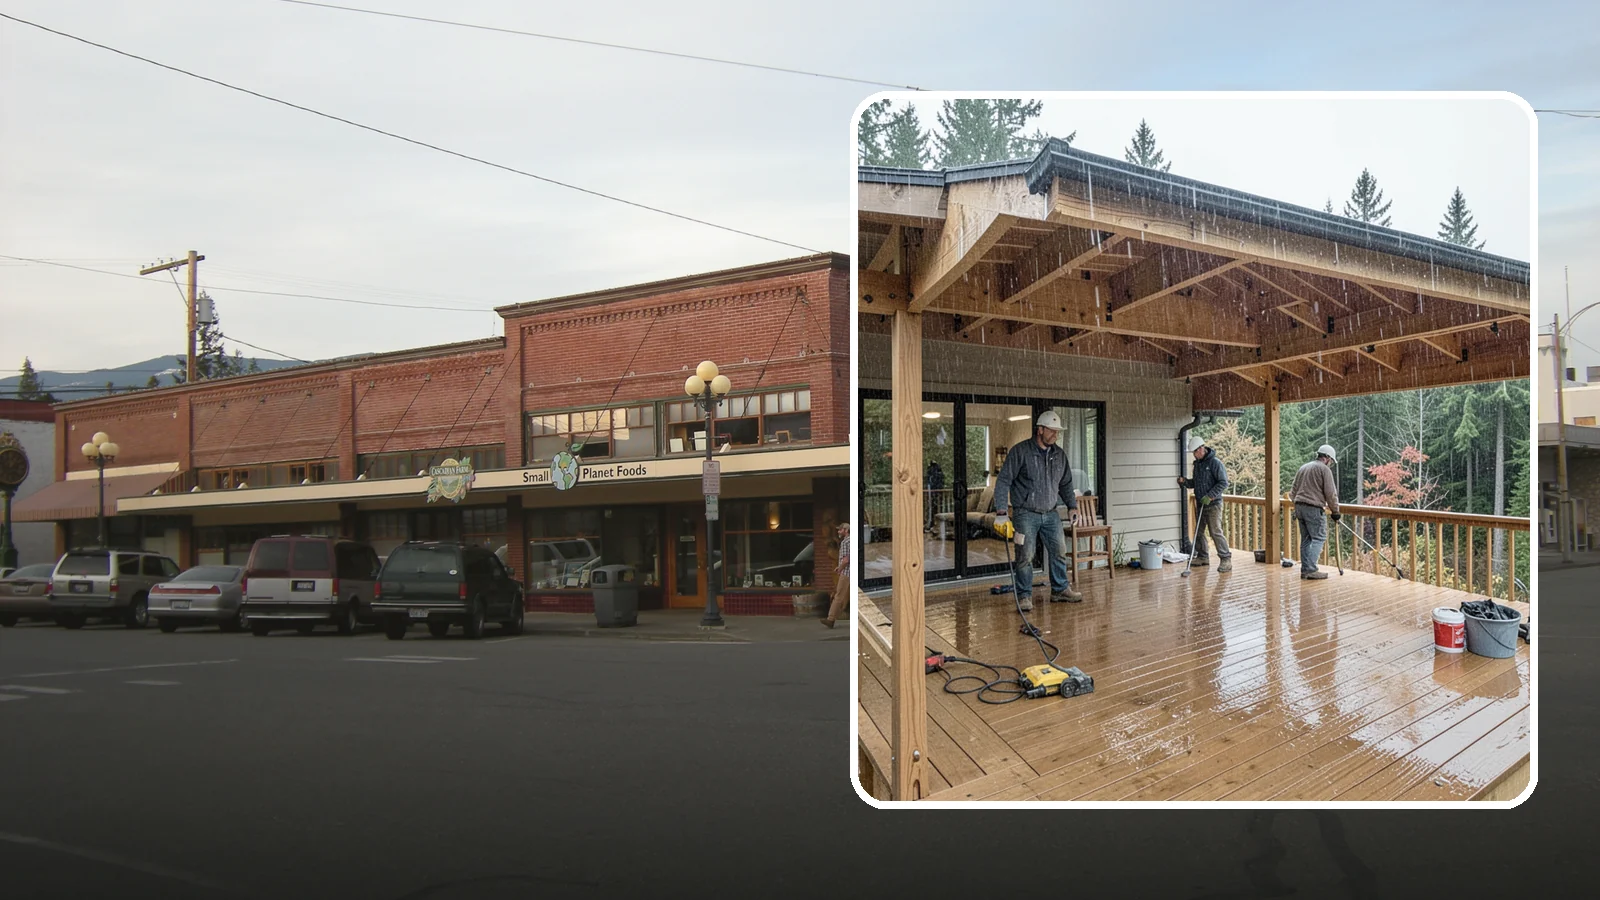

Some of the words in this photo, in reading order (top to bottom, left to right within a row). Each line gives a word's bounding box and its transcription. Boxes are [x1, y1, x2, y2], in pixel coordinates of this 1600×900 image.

[523, 471, 549, 482] Small
[583, 468, 614, 479] Planet
[617, 464, 647, 476] Foods
